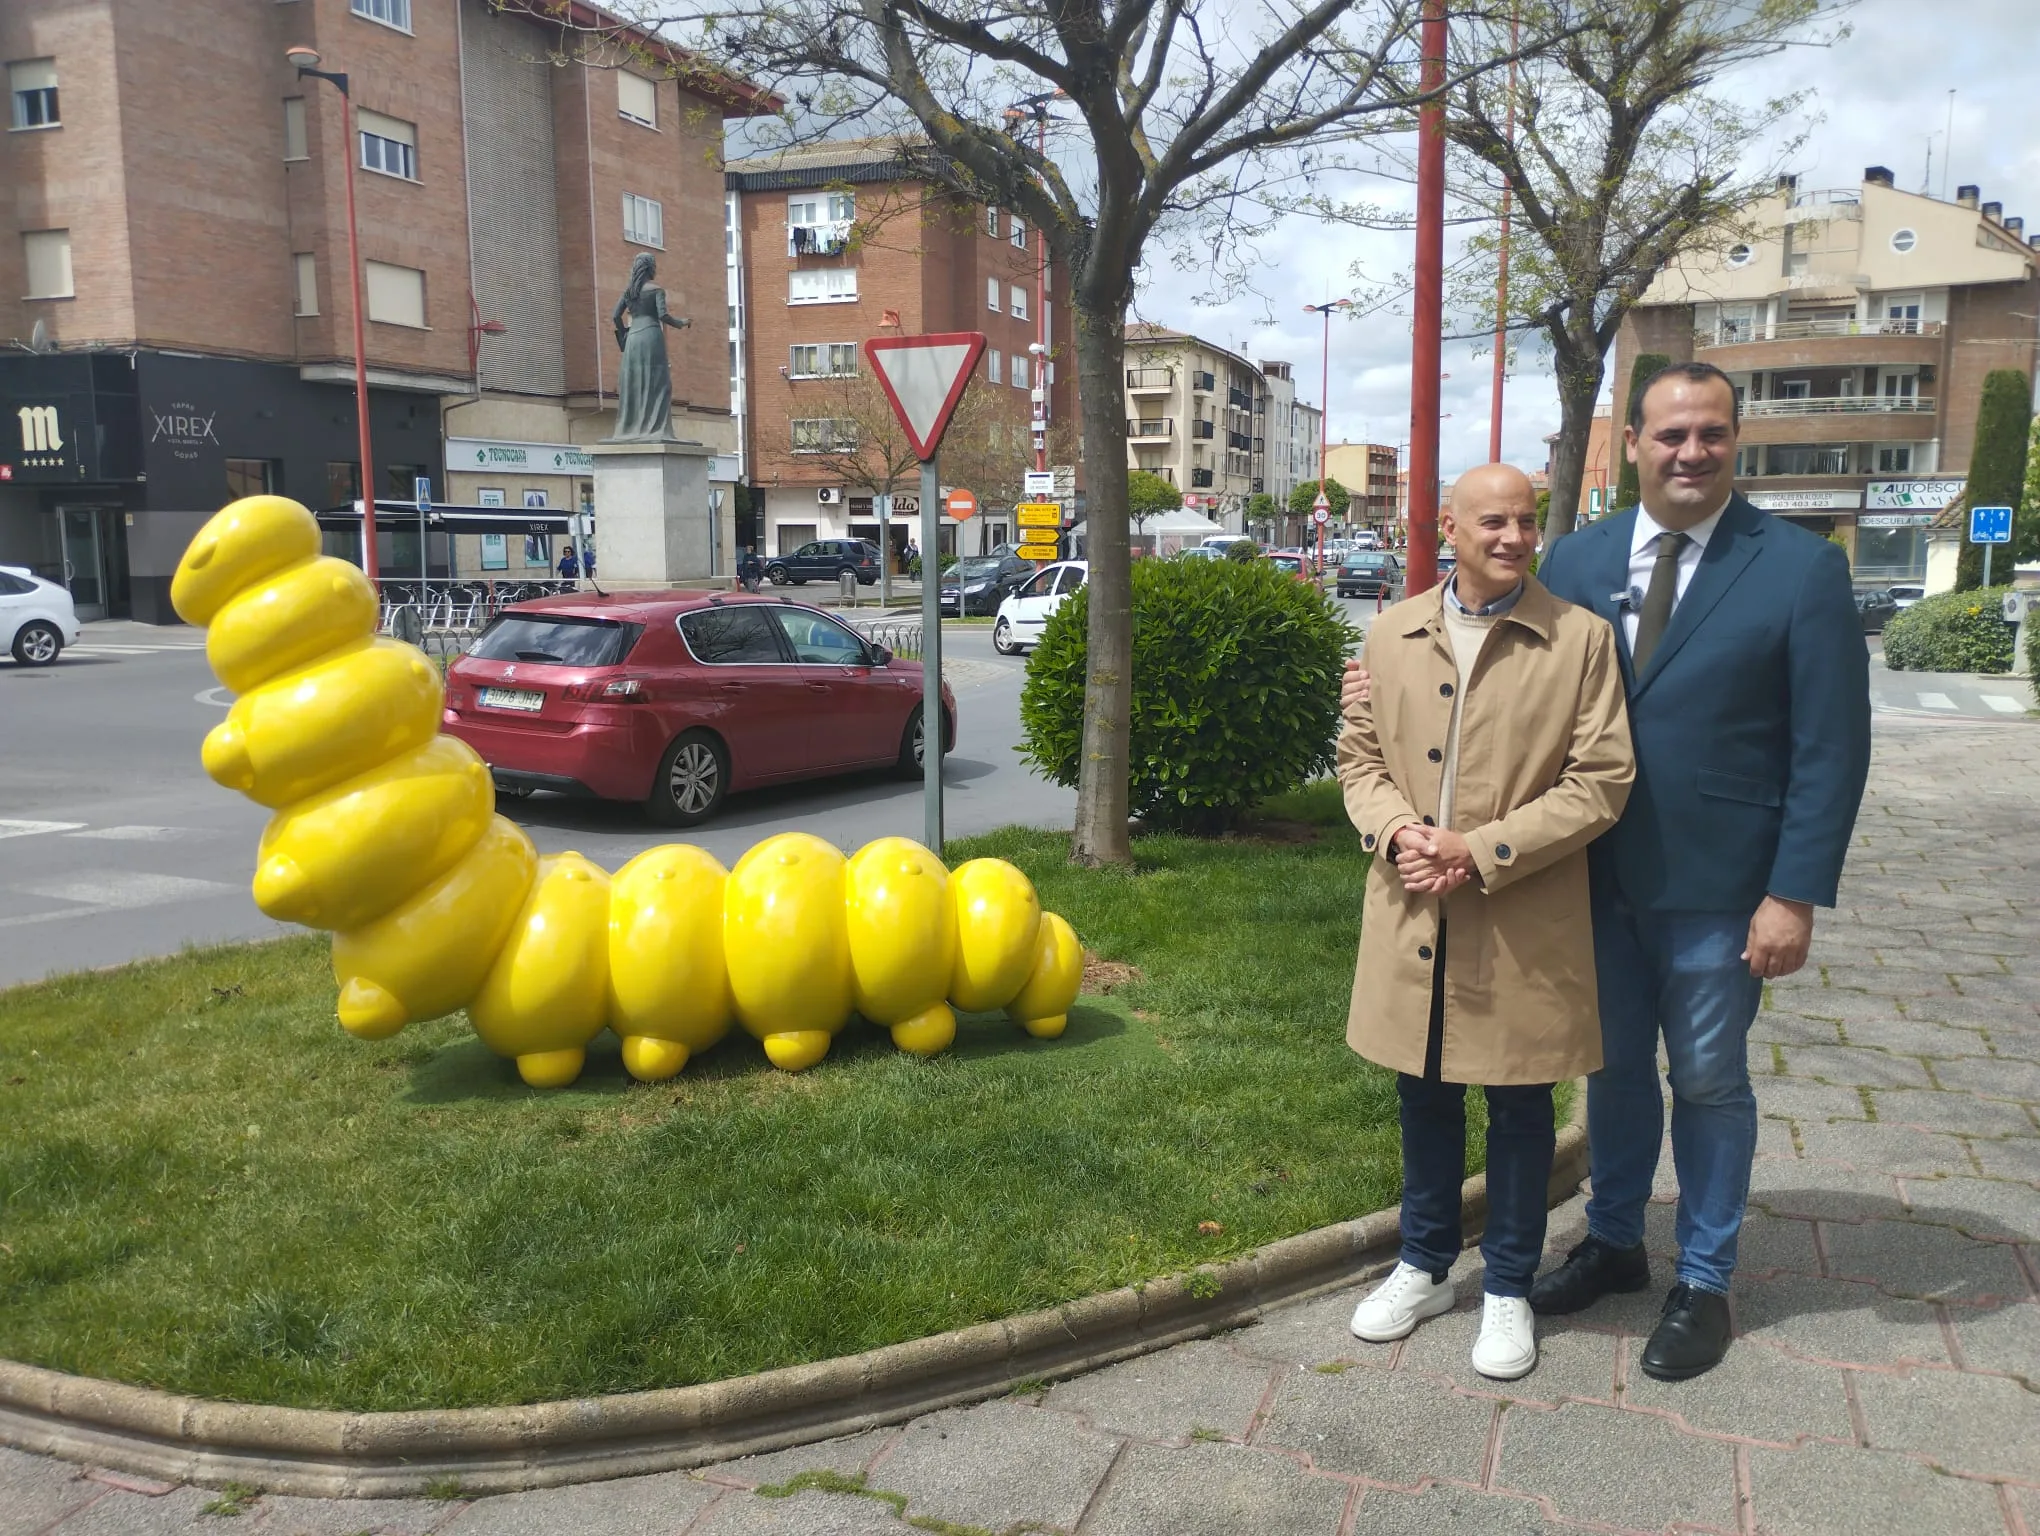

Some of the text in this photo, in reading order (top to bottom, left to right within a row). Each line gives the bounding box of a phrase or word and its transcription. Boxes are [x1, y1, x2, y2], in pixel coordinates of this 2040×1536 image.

[152, 410, 217, 442] XIREX
[488, 448, 527, 463] TECNOCASA
[529, 523, 549, 531] XIREX
